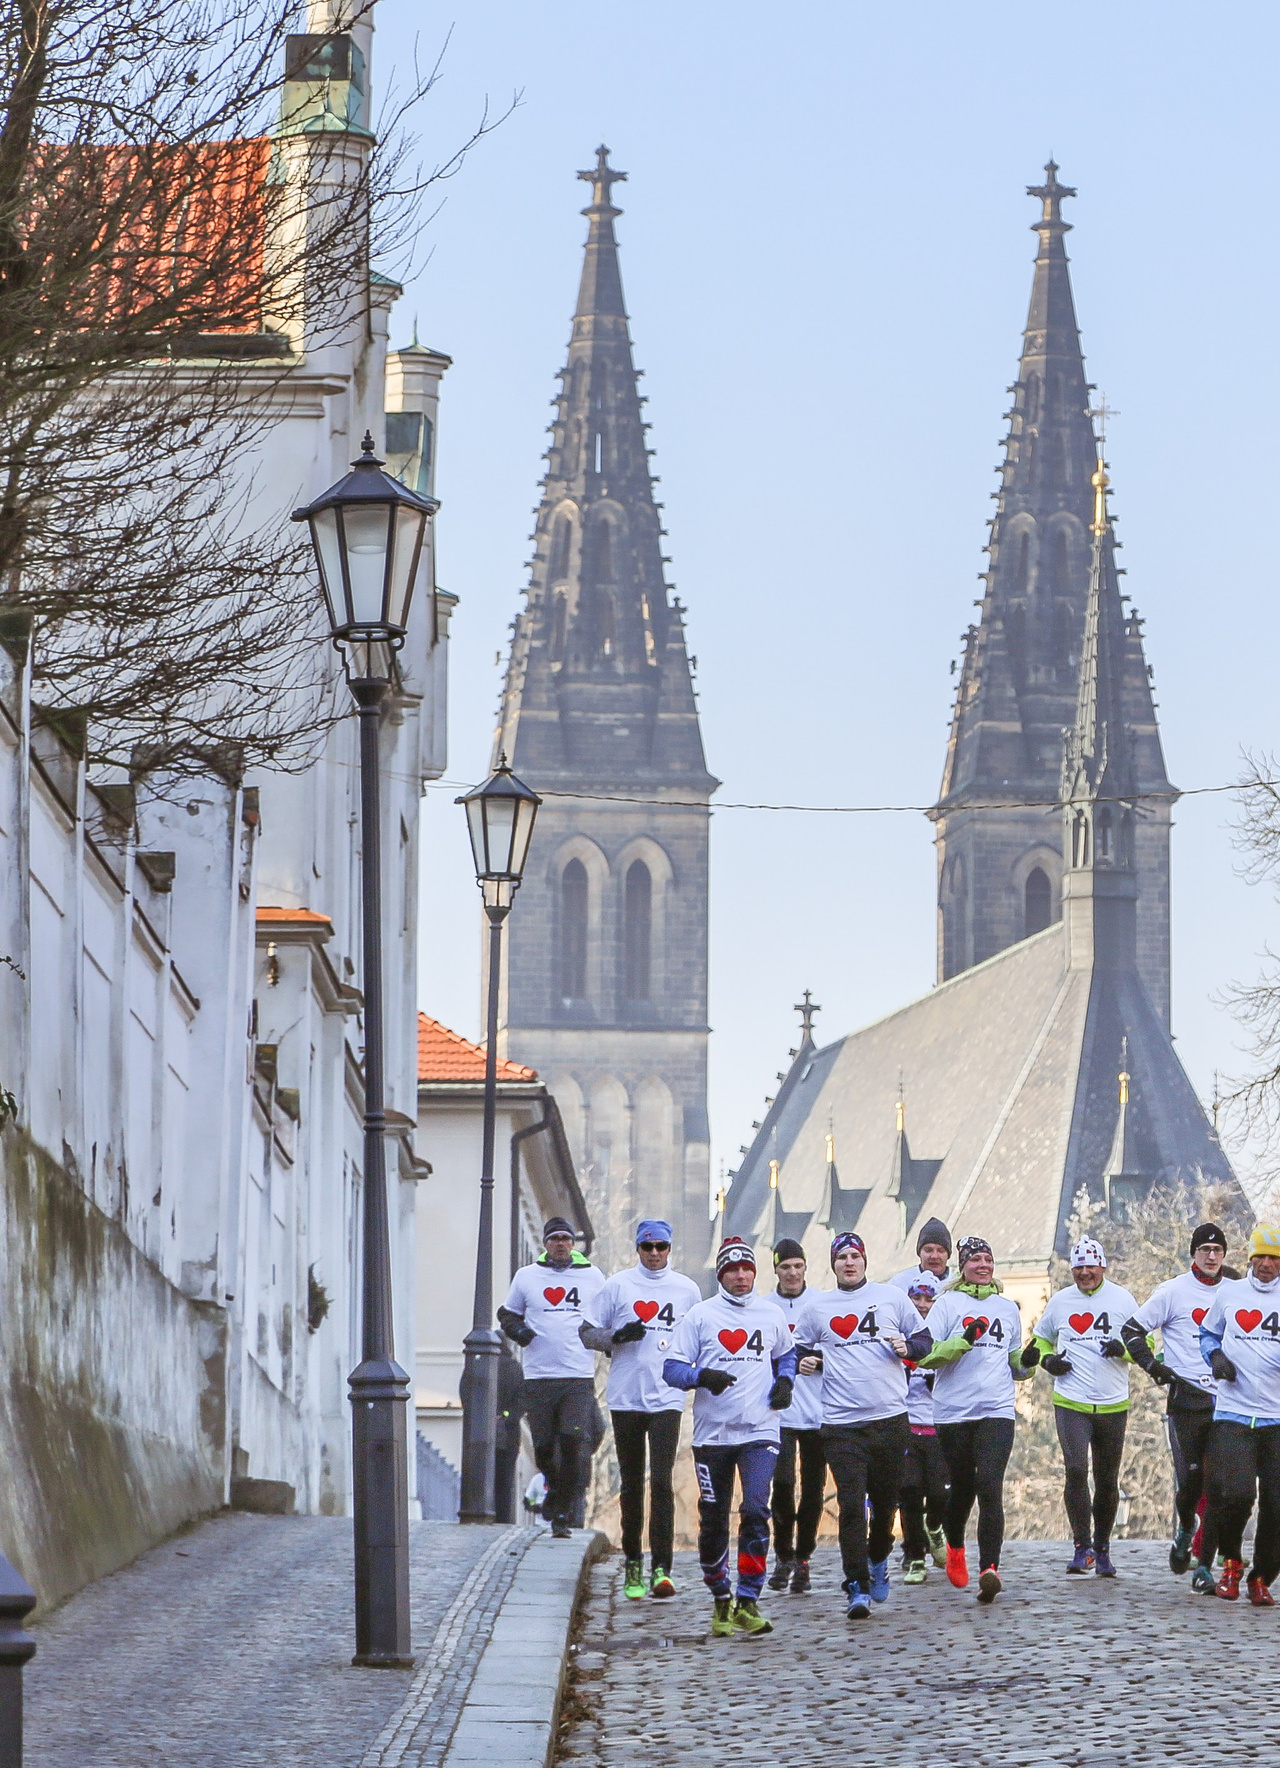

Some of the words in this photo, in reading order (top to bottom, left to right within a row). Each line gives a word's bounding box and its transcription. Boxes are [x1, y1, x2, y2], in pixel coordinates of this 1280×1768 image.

[565, 1287, 581, 1307] 4
[657, 1302, 675, 1326] 4
[858, 1311, 880, 1337] 4
[1093, 1311, 1112, 1335] 4
[1261, 1311, 1280, 1336] 4
[988, 1318, 1005, 1342] 4
[746, 1329, 764, 1356] 4
[697, 1462, 716, 1503] CZECH
